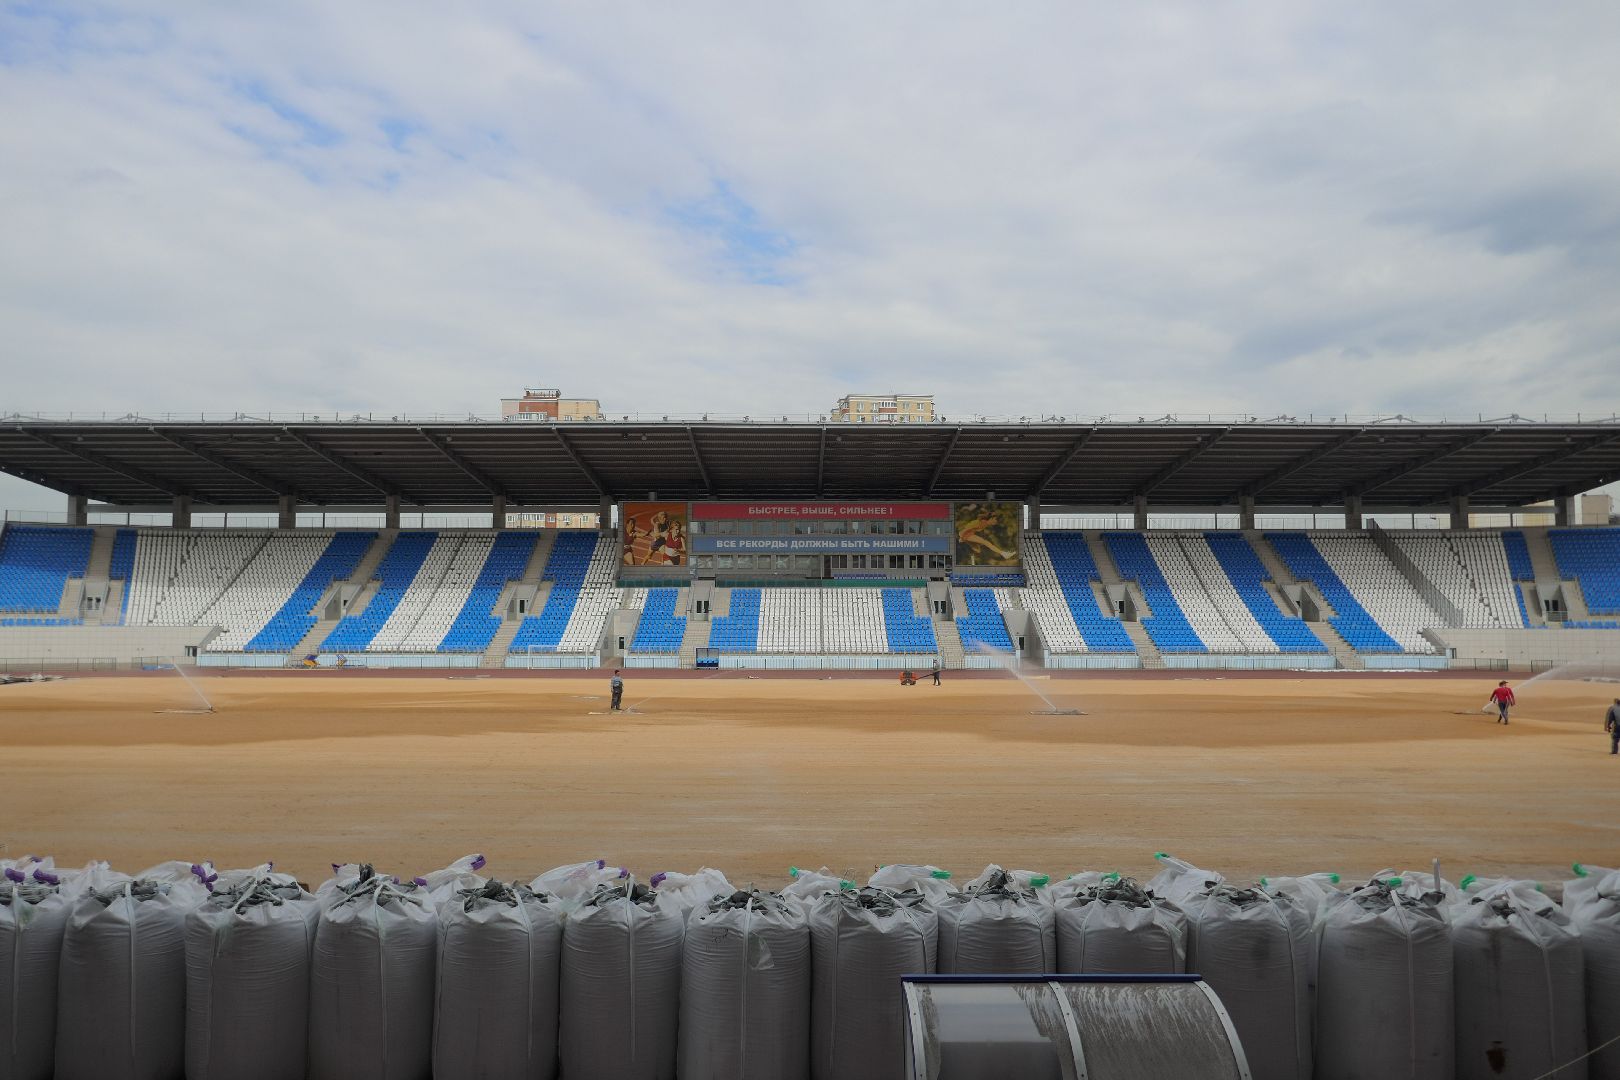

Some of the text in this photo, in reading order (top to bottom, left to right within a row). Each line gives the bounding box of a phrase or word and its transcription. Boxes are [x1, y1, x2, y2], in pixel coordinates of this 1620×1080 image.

[748, 506, 800, 516] БЫСТРЕЕ,
[802, 506, 837, 516] ВЫШЕ,
[839, 506, 887, 515] СИЛЬНЕЕ
[716, 540, 737, 548] ВСЕ
[739, 540, 788, 549] РЕКОРДЫ
[790, 540, 838, 549] ДОЛЖНЫ
[841, 540, 871, 548] БЫТЬ
[872, 540, 919, 548] НАШИМИ
